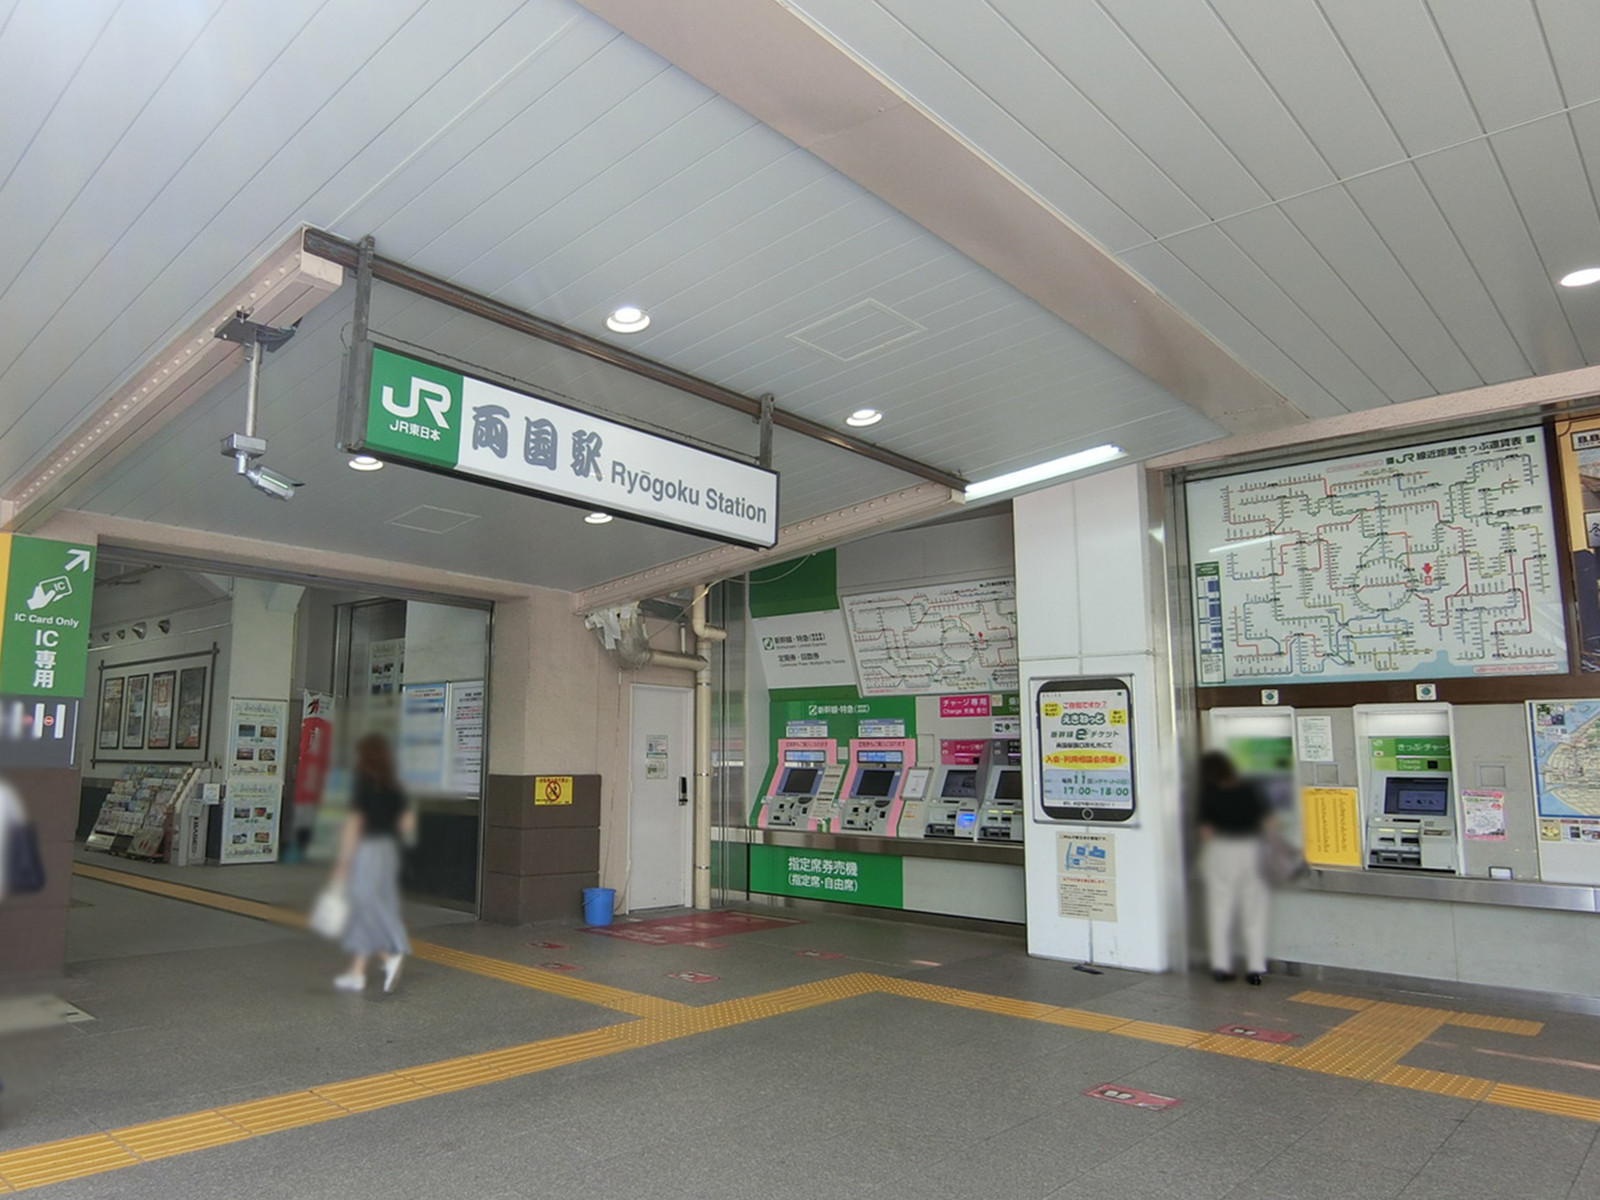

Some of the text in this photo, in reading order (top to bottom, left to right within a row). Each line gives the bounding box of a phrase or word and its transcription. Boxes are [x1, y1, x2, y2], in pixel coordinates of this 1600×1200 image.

[382, 376, 452, 430] JR
[389, 419, 442, 442] JR東日本
[611, 459, 768, 524] Ryōgoku Station
[15, 612, 80, 629] IC Card Only
[33, 630, 59, 689] IC専用
[1061, 712, 1106, 726] えきねっと
[788, 856, 858, 877] 指定席券売機
